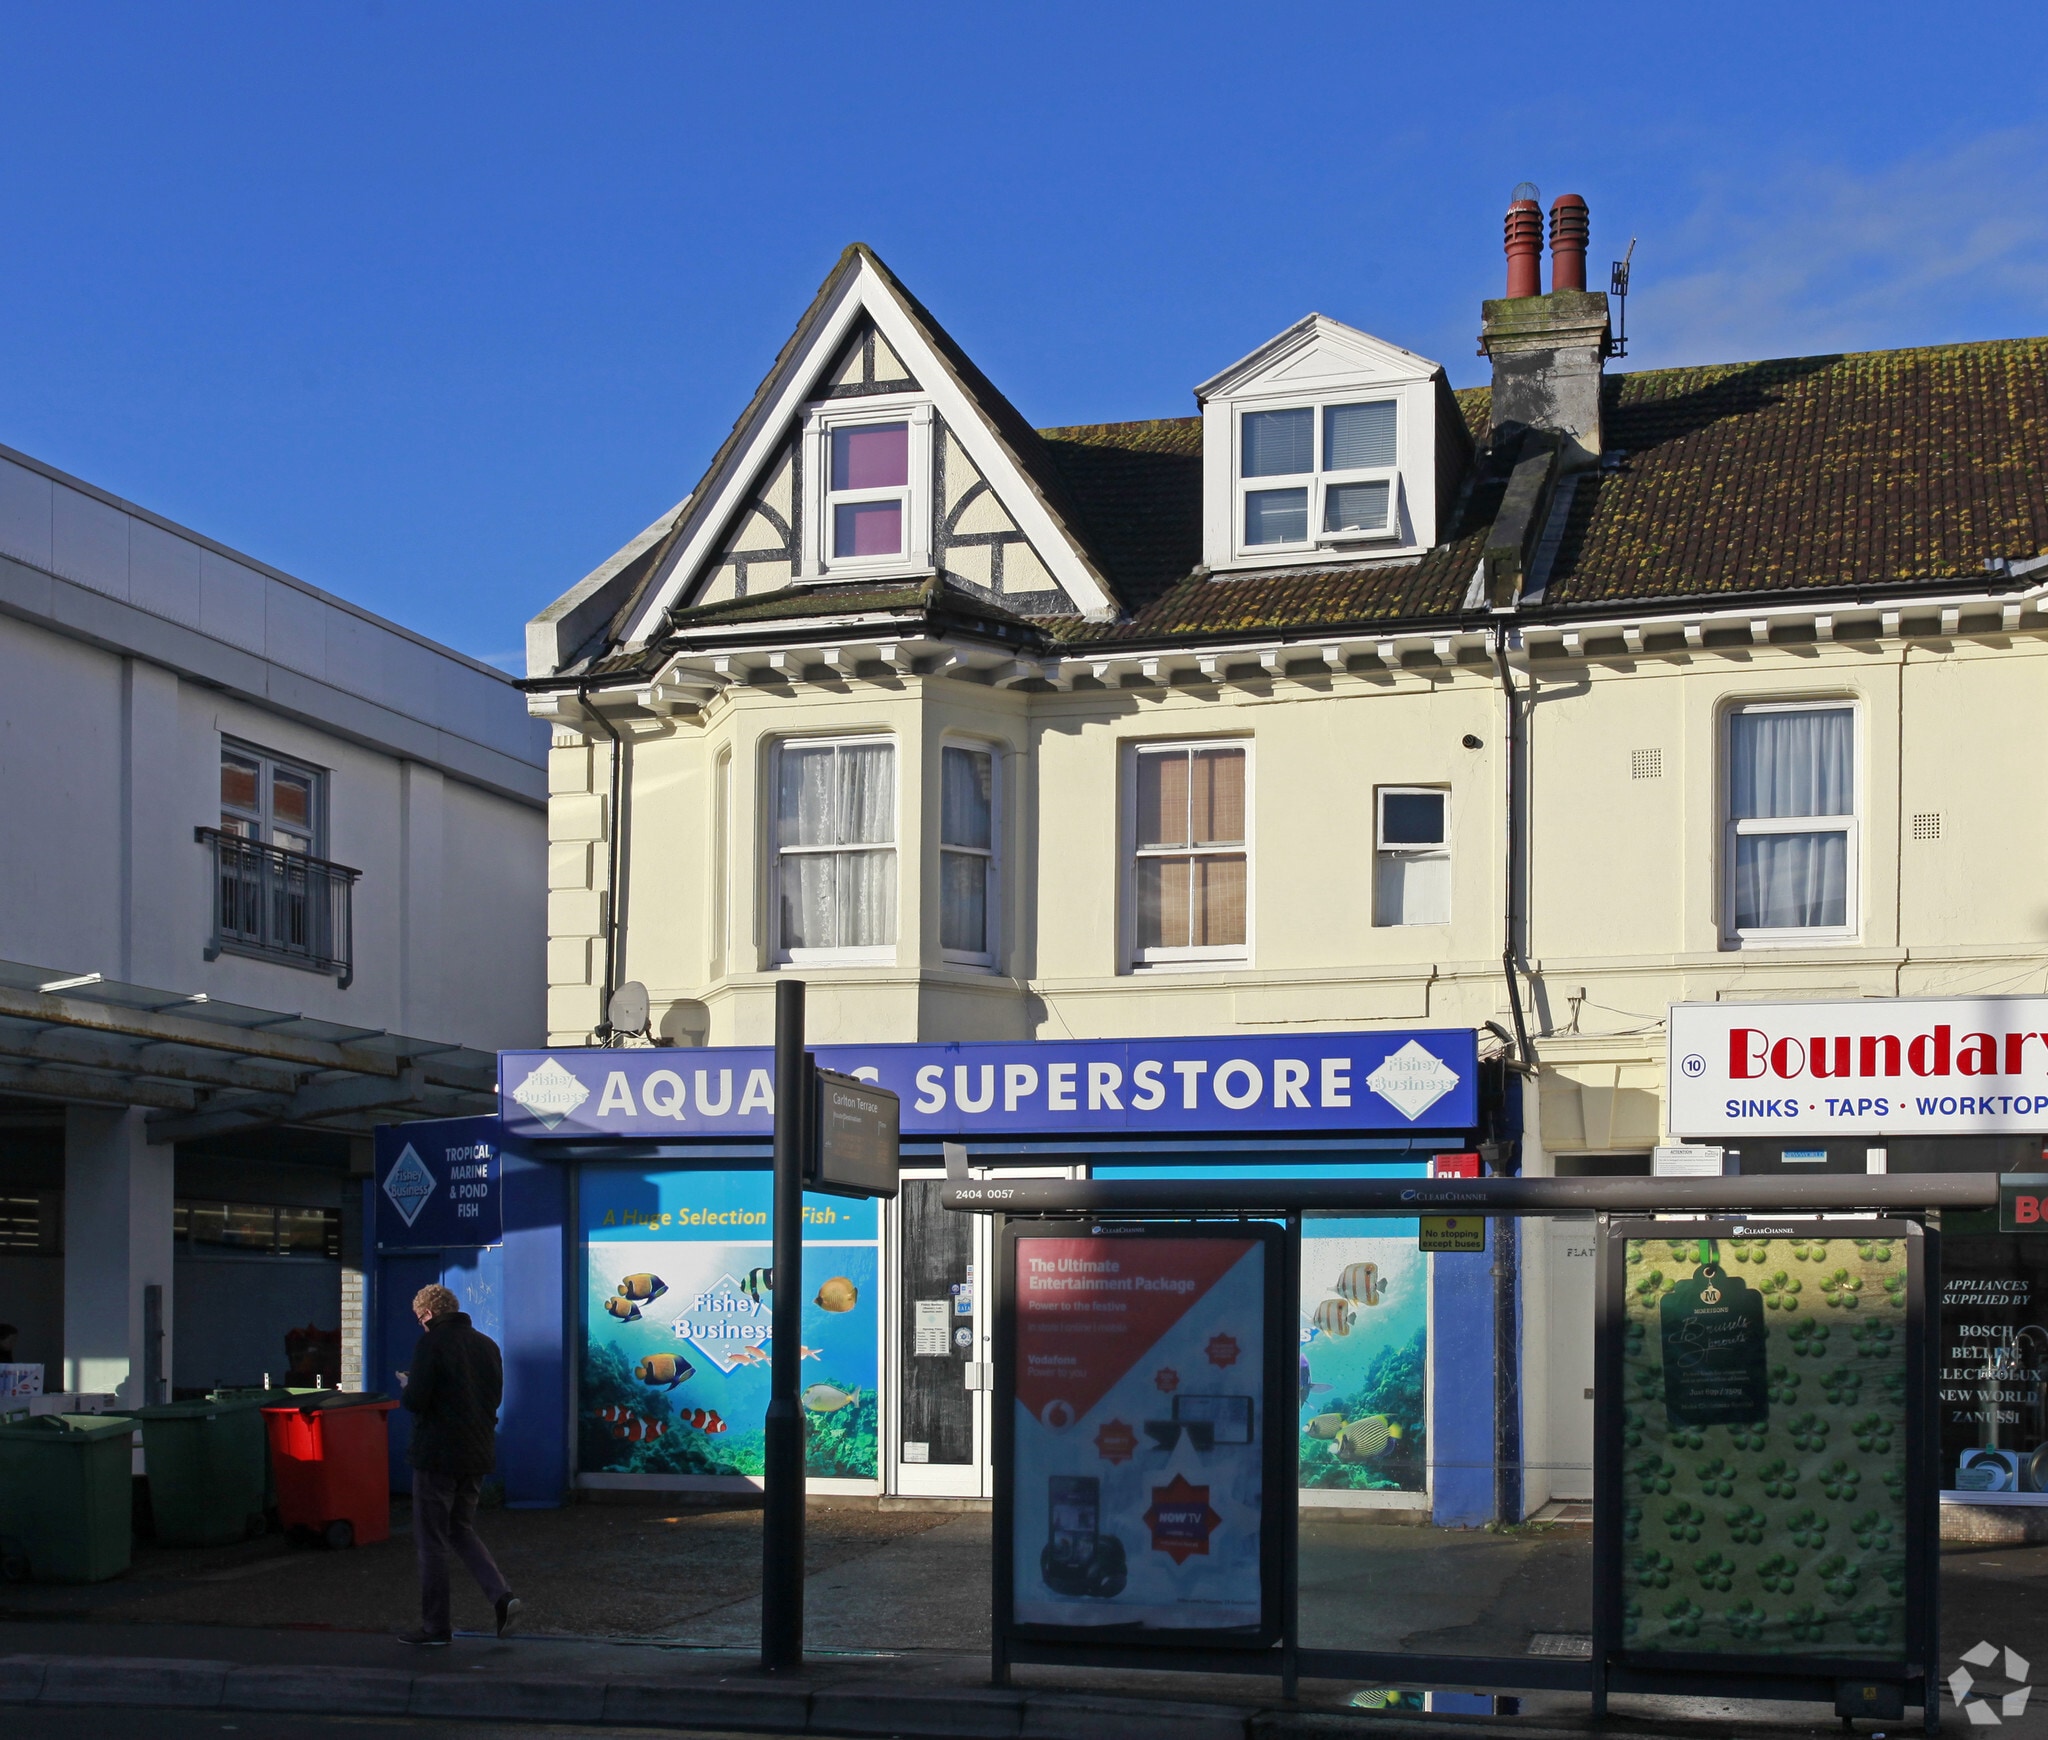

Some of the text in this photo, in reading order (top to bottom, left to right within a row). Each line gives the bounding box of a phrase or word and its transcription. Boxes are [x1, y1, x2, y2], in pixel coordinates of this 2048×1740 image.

[1686, 1059, 1701, 1072] 10
[597, 1057, 1351, 1121] AQUA SUPERSTORE
[833, 1092, 878, 1113] Carlton Terrace
[1726, 1096, 2048, 1118] SINKS TAPS WORKTOP
[446, 1145, 493, 1161] TROPICAL,
[451, 1164, 488, 1180] MARINE
[390, 1184, 430, 1198] Business
[450, 1184, 488, 1199] & POND
[956, 1189, 1014, 1199] 2404 0057
[458, 1203, 479, 1217] FISH
[603, 1209, 615, 1226] A
[622, 1208, 672, 1231] Huge
[678, 1207, 767, 1226] Selection
[1425, 1230, 1479, 1242] No stopping
[1422, 1240, 1481, 1250] except buses
[1029, 1258, 1120, 1273] The Ultimate
[1029, 1276, 1195, 1294] Entertainment Package
[1944, 1280, 2029, 1291] APPLIANCES
[1704, 1292, 1717, 1302] M
[1942, 1294, 2031, 1305] SUPPLIED BY
[693, 1292, 762, 1317] Fishey
[1029, 1301, 1127, 1312] Power to the festive
[1960, 1325, 2014, 1337] BOSCH
[1028, 1354, 1077, 1365] Vodafone
[1028, 1368, 1087, 1381] Power to you
[1977, 1390, 2038, 1402] WORLD
[1159, 1512, 1202, 1524] NOW TV
